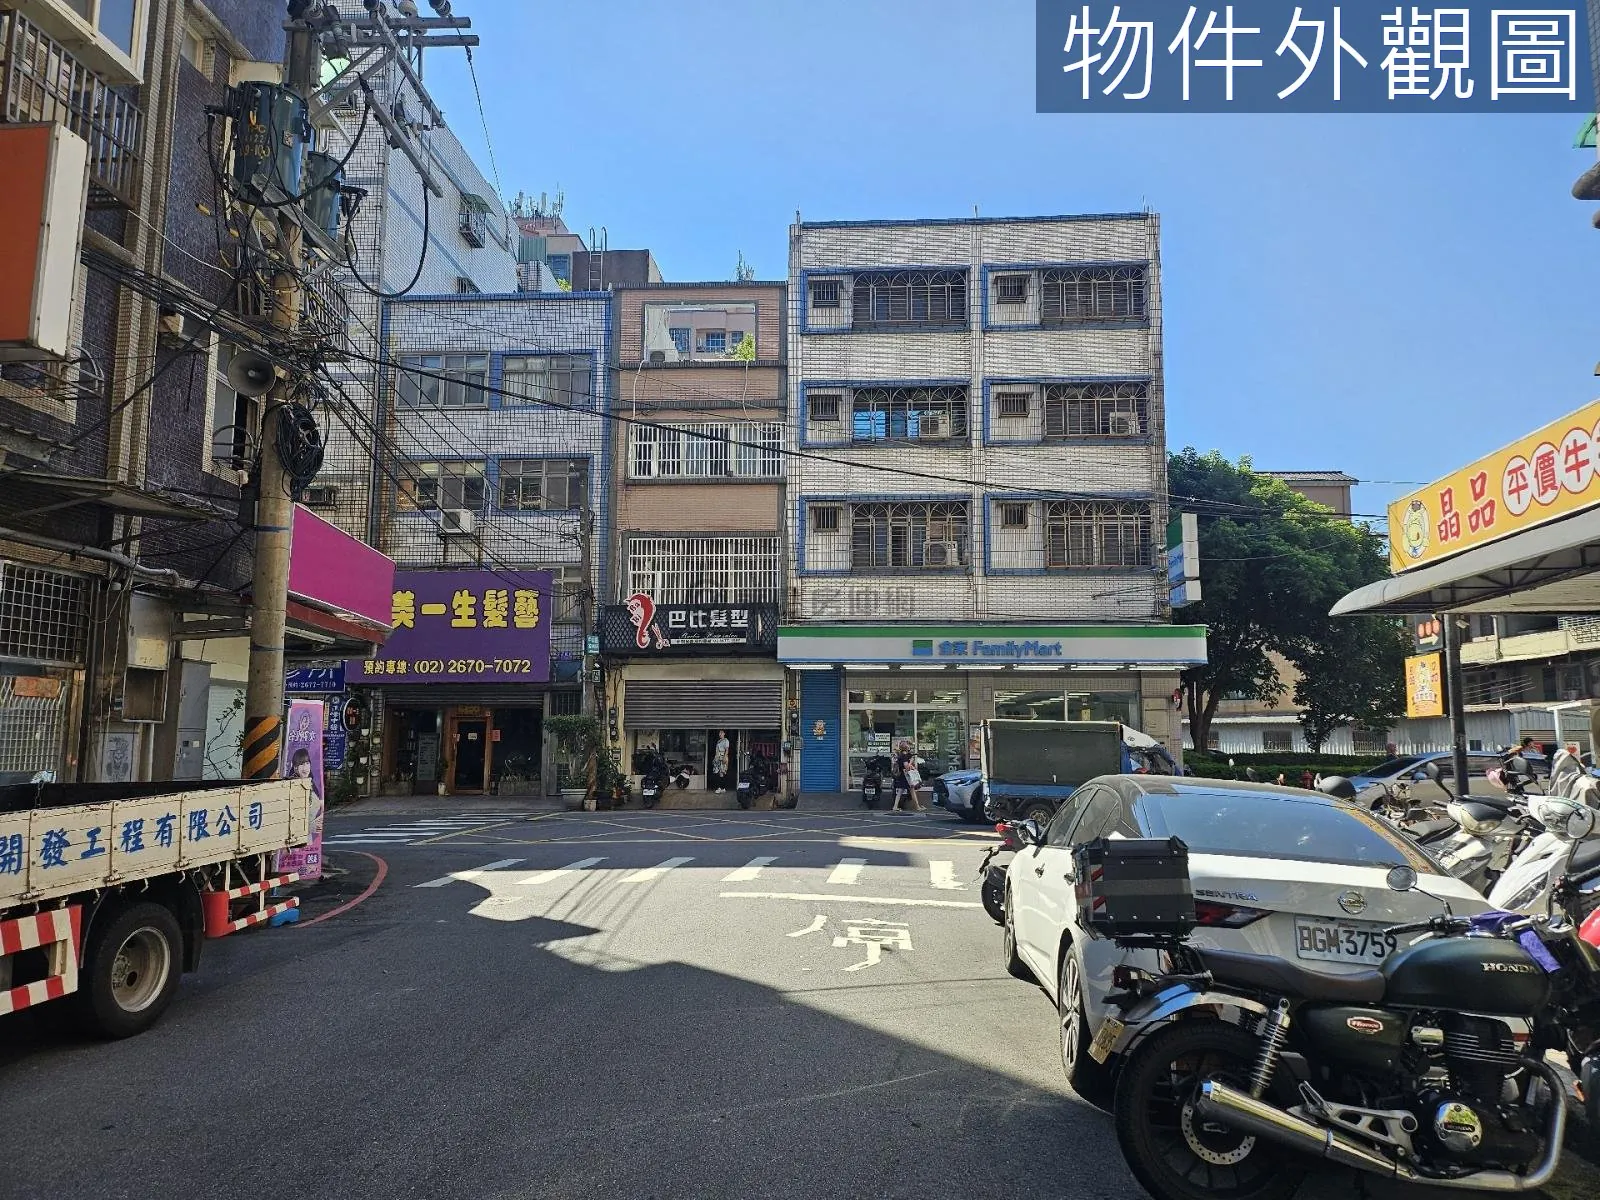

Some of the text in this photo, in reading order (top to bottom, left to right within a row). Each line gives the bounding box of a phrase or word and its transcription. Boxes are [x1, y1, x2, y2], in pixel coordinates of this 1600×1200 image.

[1437, 430, 1600, 542] 晶品 平價牛
[668, 609, 749, 628] 巴比髮型
[973, 640, 1063, 658] FamilyMart
[0, 801, 265, 876] 開發工程有限公司
[1195, 889, 1259, 902] SENTRA
[785, 914, 915, 972] 停
[1299, 924, 1398, 959] BGM-3759
[1480, 962, 1540, 974] HONDA
